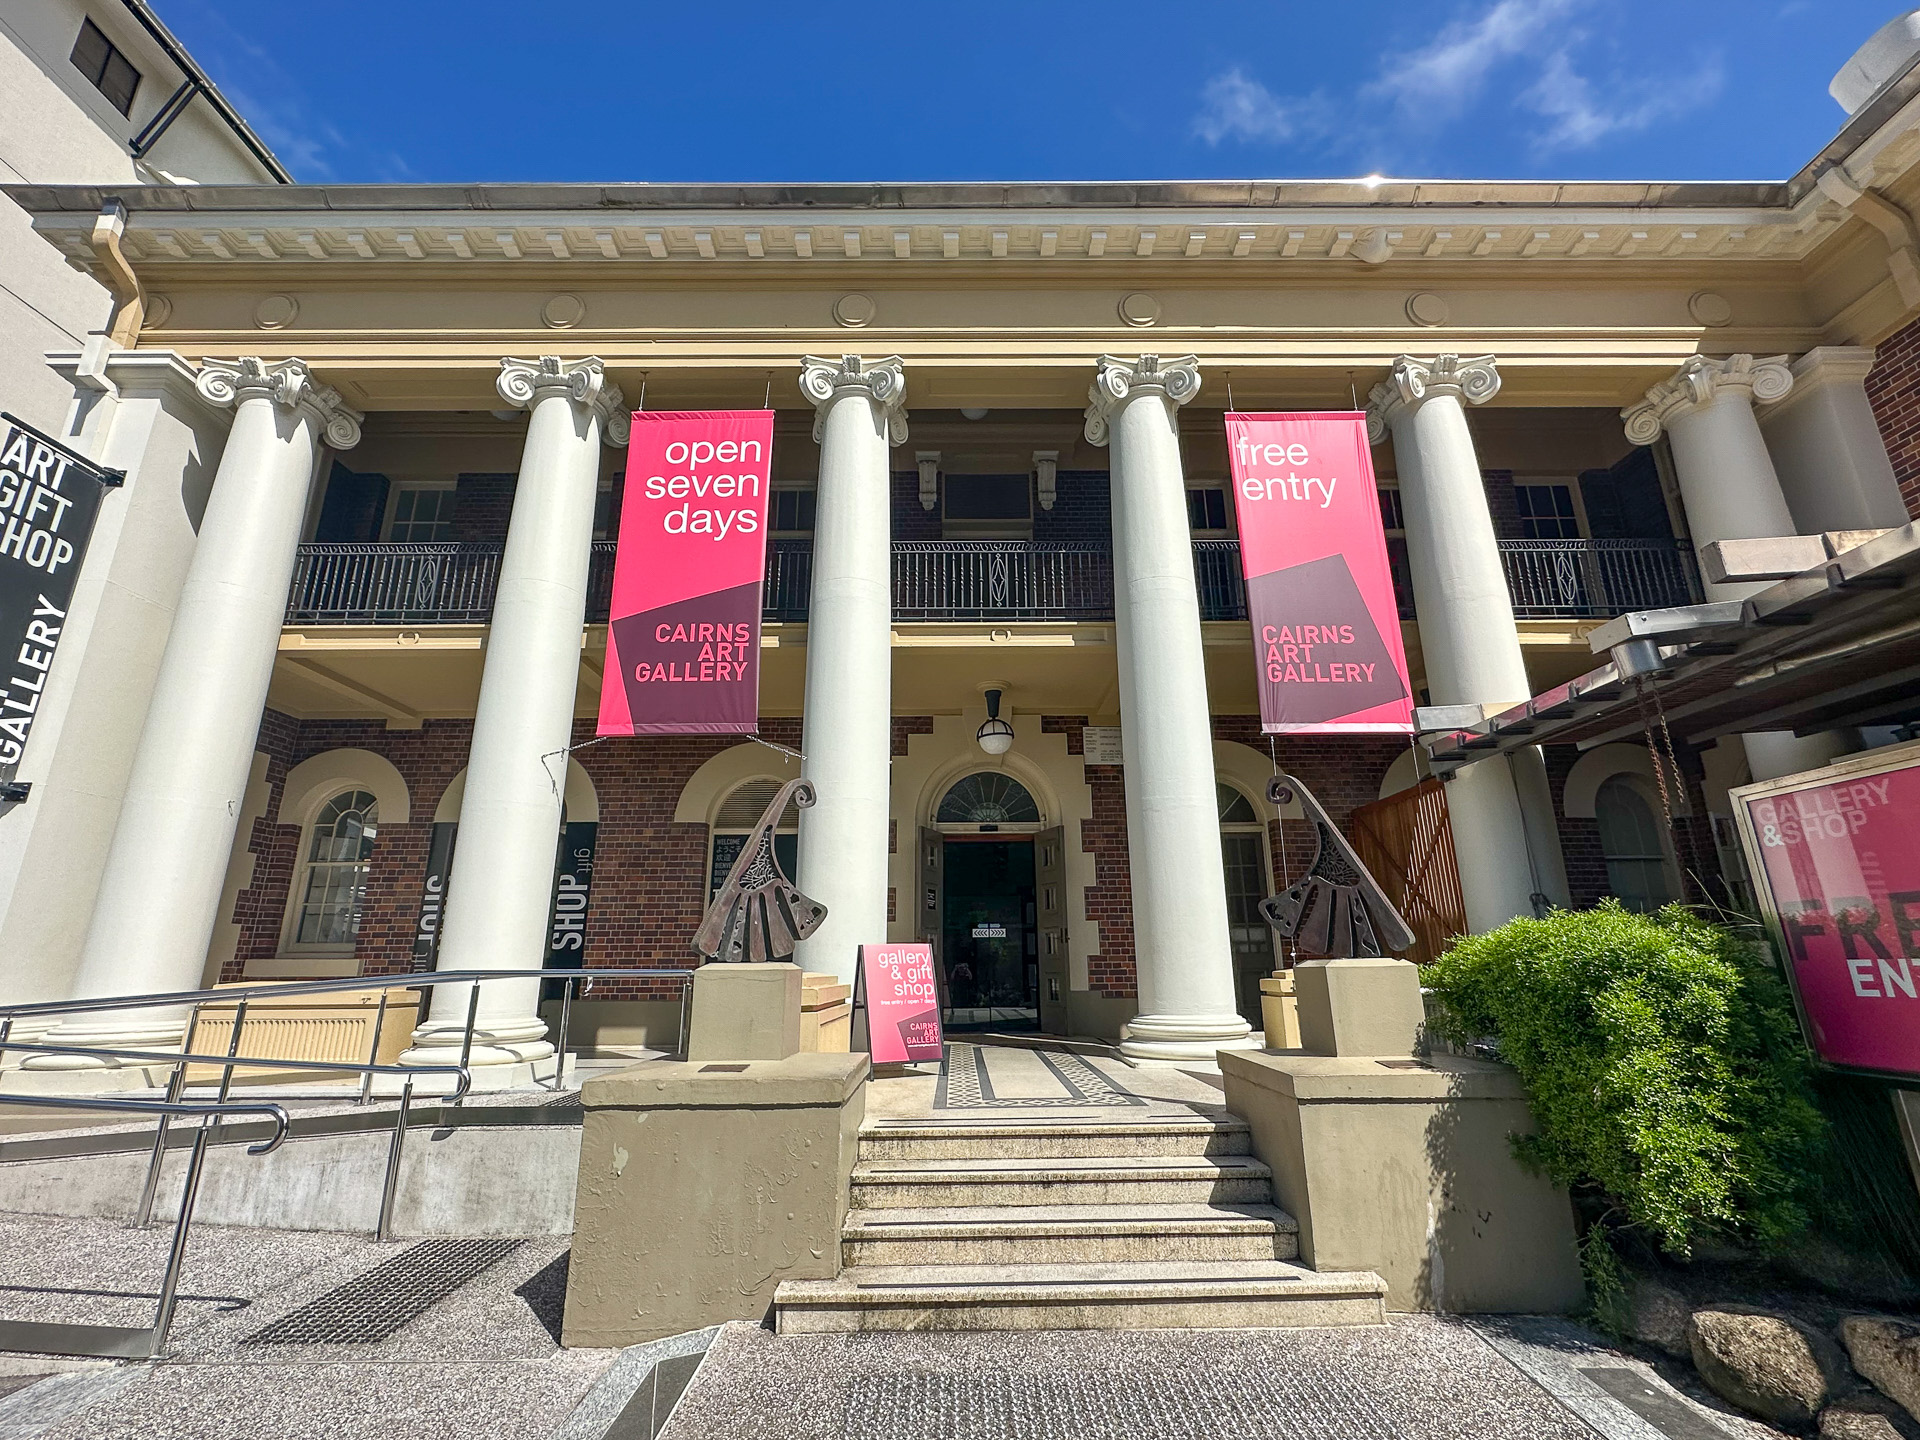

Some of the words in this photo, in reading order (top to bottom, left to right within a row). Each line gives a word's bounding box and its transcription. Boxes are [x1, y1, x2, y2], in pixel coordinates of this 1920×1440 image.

[1, 433, 74, 491] ART
[665, 440, 762, 470] open
[1236, 436, 1309, 466] free
[644, 474, 759, 500] seven
[1241, 472, 1337, 508] entry
[663, 503, 758, 541] days
[0, 511, 74, 574] HOP
[655, 623, 750, 643] CAIRNS
[1262, 625, 1355, 644] CAIRNS
[697, 642, 750, 662] ART
[1266, 644, 1314, 664] ART
[0, 593, 66, 765] GALLERY
[635, 661, 748, 682] GALLERY
[1266, 663, 1376, 683] GALLERY
[1756, 778, 1890, 825] GALLERY
[573, 848, 594, 874] gift
[552, 874, 588, 950] SHOP
[878, 949, 930, 968] gallery
[891, 964, 903, 980] &
[907, 964, 933, 984] gift
[1846, 958, 1920, 998] EN
[894, 980, 935, 999] shop
[910, 1022, 938, 1031] CAIRNS
[924, 1029, 939, 1037] ART
[906, 1036, 939, 1045] GALLERY
